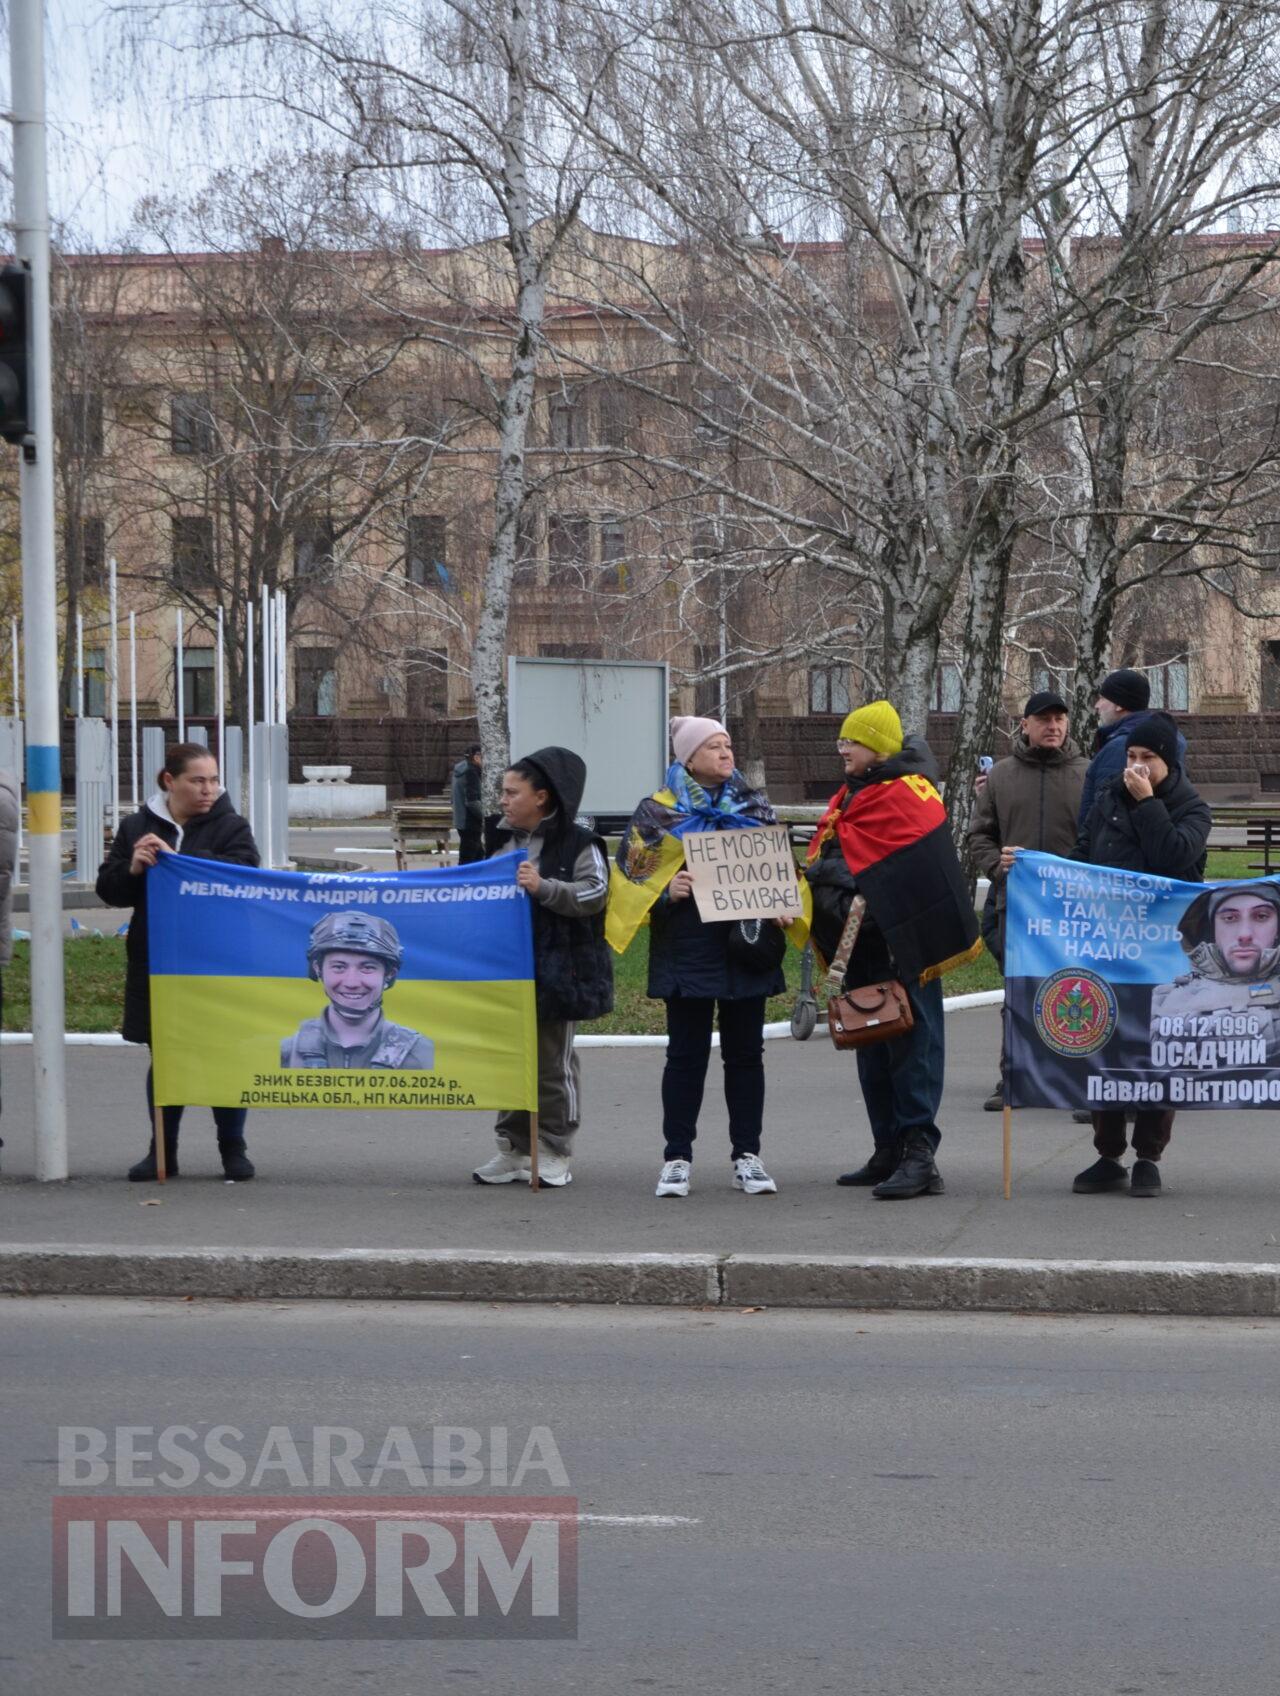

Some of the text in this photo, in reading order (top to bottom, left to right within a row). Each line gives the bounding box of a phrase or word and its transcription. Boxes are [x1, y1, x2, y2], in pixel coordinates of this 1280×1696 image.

[688, 831, 789, 863] НЕ МОВЧИ
[1037, 865, 1173, 891] «МІЖ НЕБОМ
[179, 880, 300, 902] МЕЛЬНИЧУК
[303, 886, 377, 905] АНДРІЙ
[712, 885, 800, 911] ВБИВАЄ!
[1053, 880, 1156, 903] ЗЕМЛЕЮ»
[1062, 901, 1148, 923] ТАМ, ДЕ
[1027, 918, 1184, 942] НЕ ВТРАЧАЮТЬ
[1064, 939, 1143, 961] НАДІЮ
[1159, 1016, 1260, 1038] 08.12.1996
[1151, 1034, 1267, 1070] ОСАДЧИЙ
[254, 1074, 462, 1091] ЗНИК БЕЗВІСТИ 07.06.2024 р.
[1087, 1075, 1164, 1102] Павло
[240, 1091, 476, 1107] ДОНЕЦЬКА ОБЛ., НП КАЛИНІВКА
